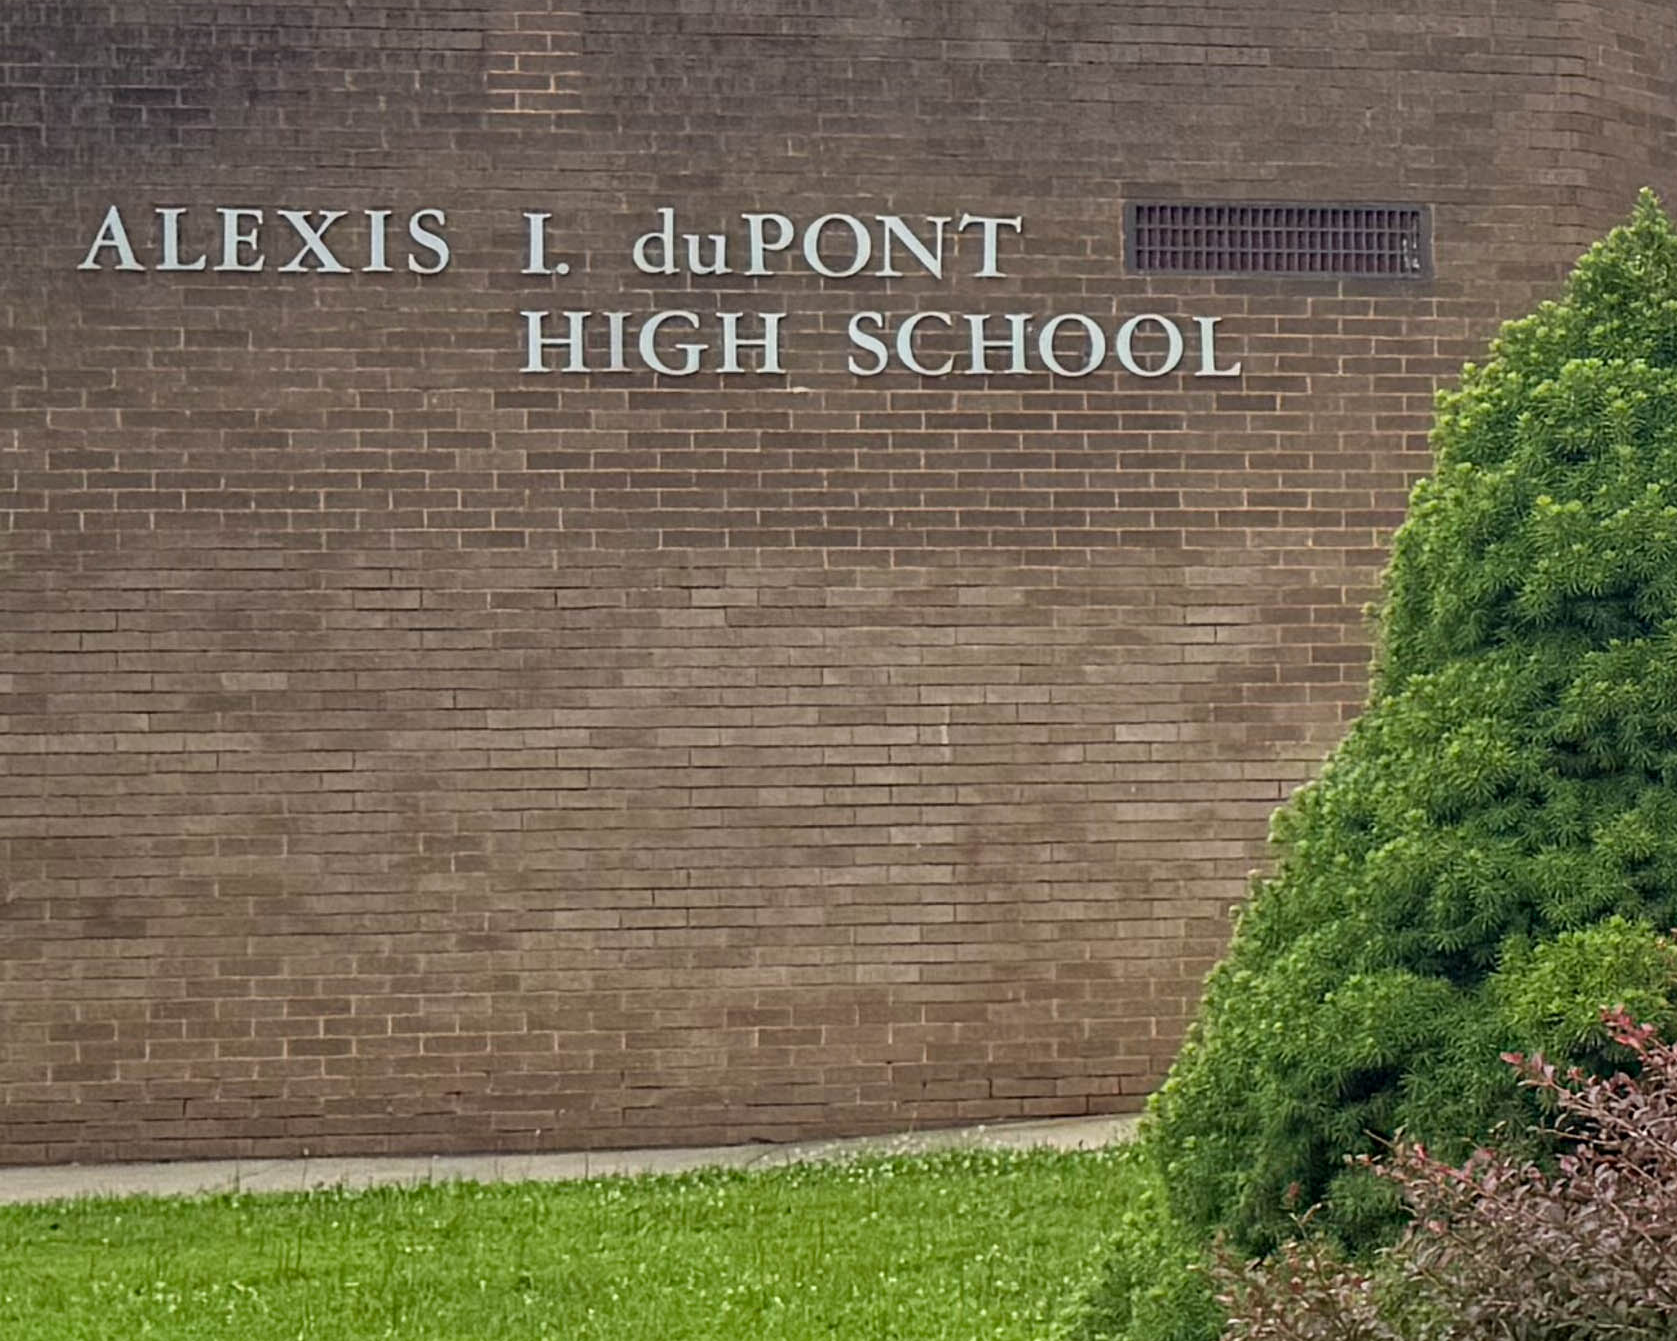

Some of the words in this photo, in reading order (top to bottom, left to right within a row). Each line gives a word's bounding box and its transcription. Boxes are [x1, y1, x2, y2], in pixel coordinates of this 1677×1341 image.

[77, 204, 451, 275] ALEXIS
[520, 212, 570, 276] I.
[632, 206, 1023, 279] duPONT
[519, 310, 787, 376] HIGH
[847, 310, 1242, 378] SCHOOL
